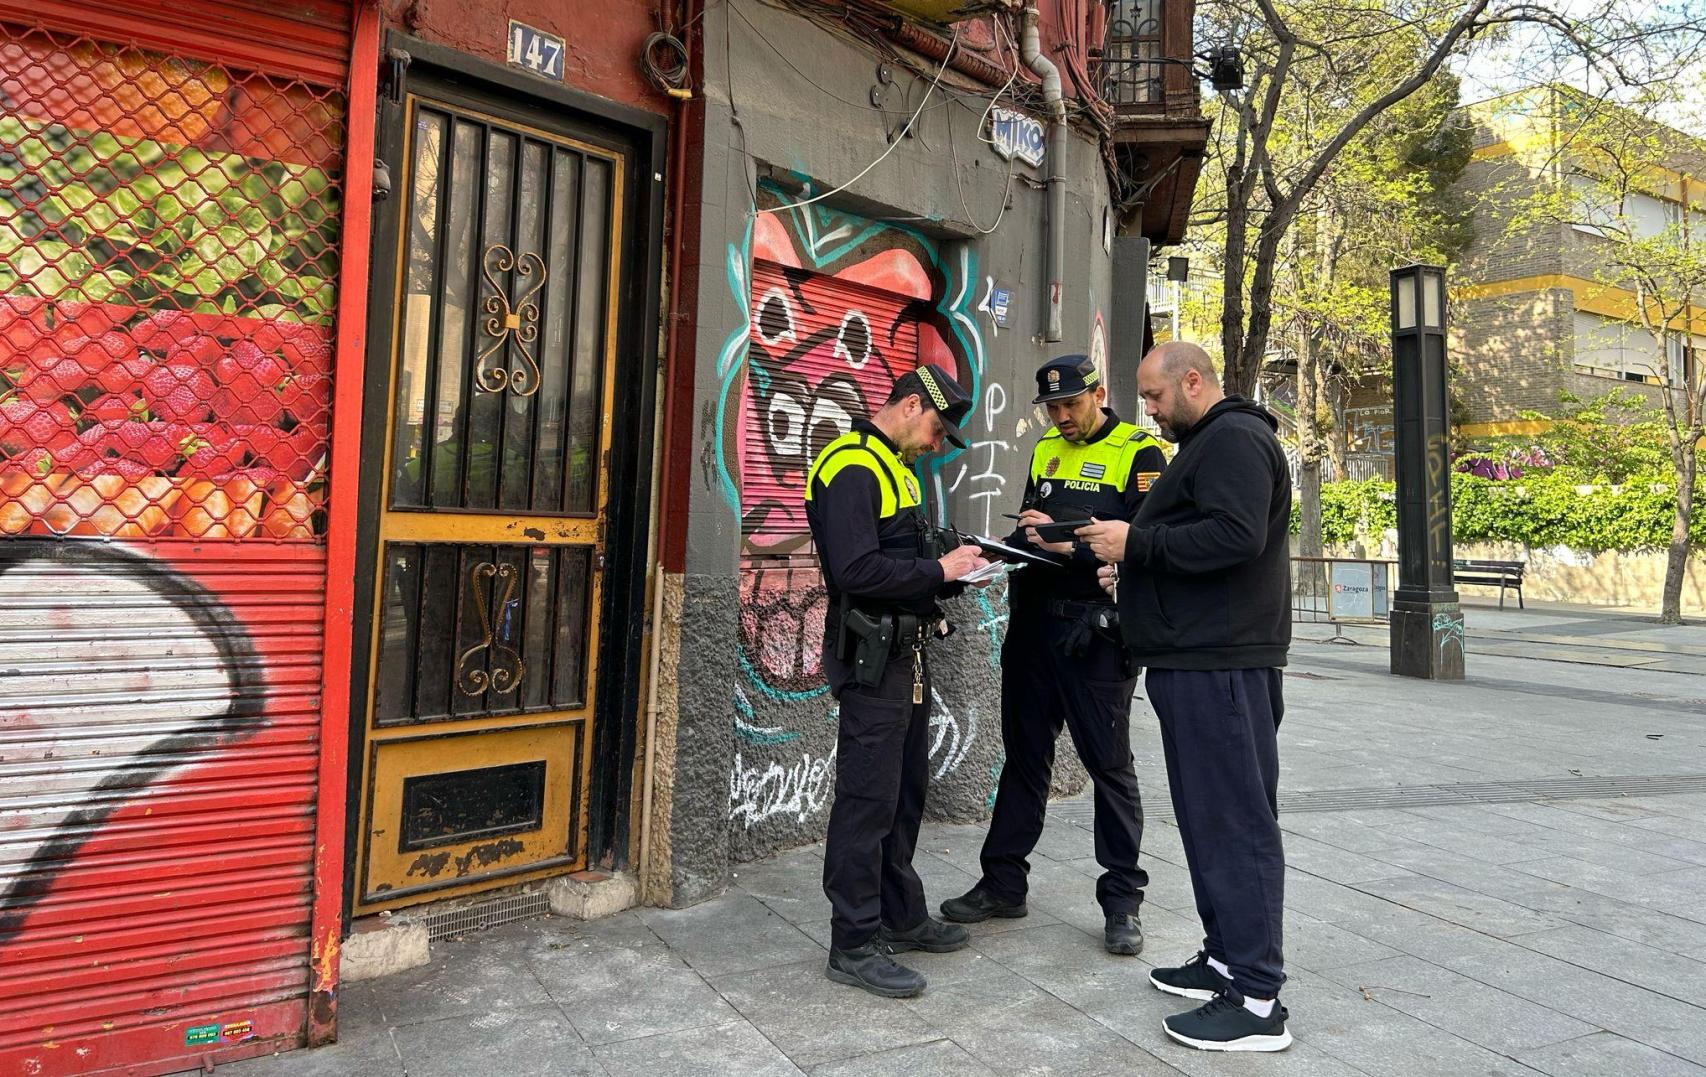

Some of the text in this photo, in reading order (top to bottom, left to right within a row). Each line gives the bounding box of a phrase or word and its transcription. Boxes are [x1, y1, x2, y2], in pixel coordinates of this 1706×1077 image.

[513, 27, 561, 76] 147
[995, 110, 1041, 151] MIKO
[1064, 480, 1100, 492] POLICIA
[1343, 585, 1369, 593] Zaragoza
